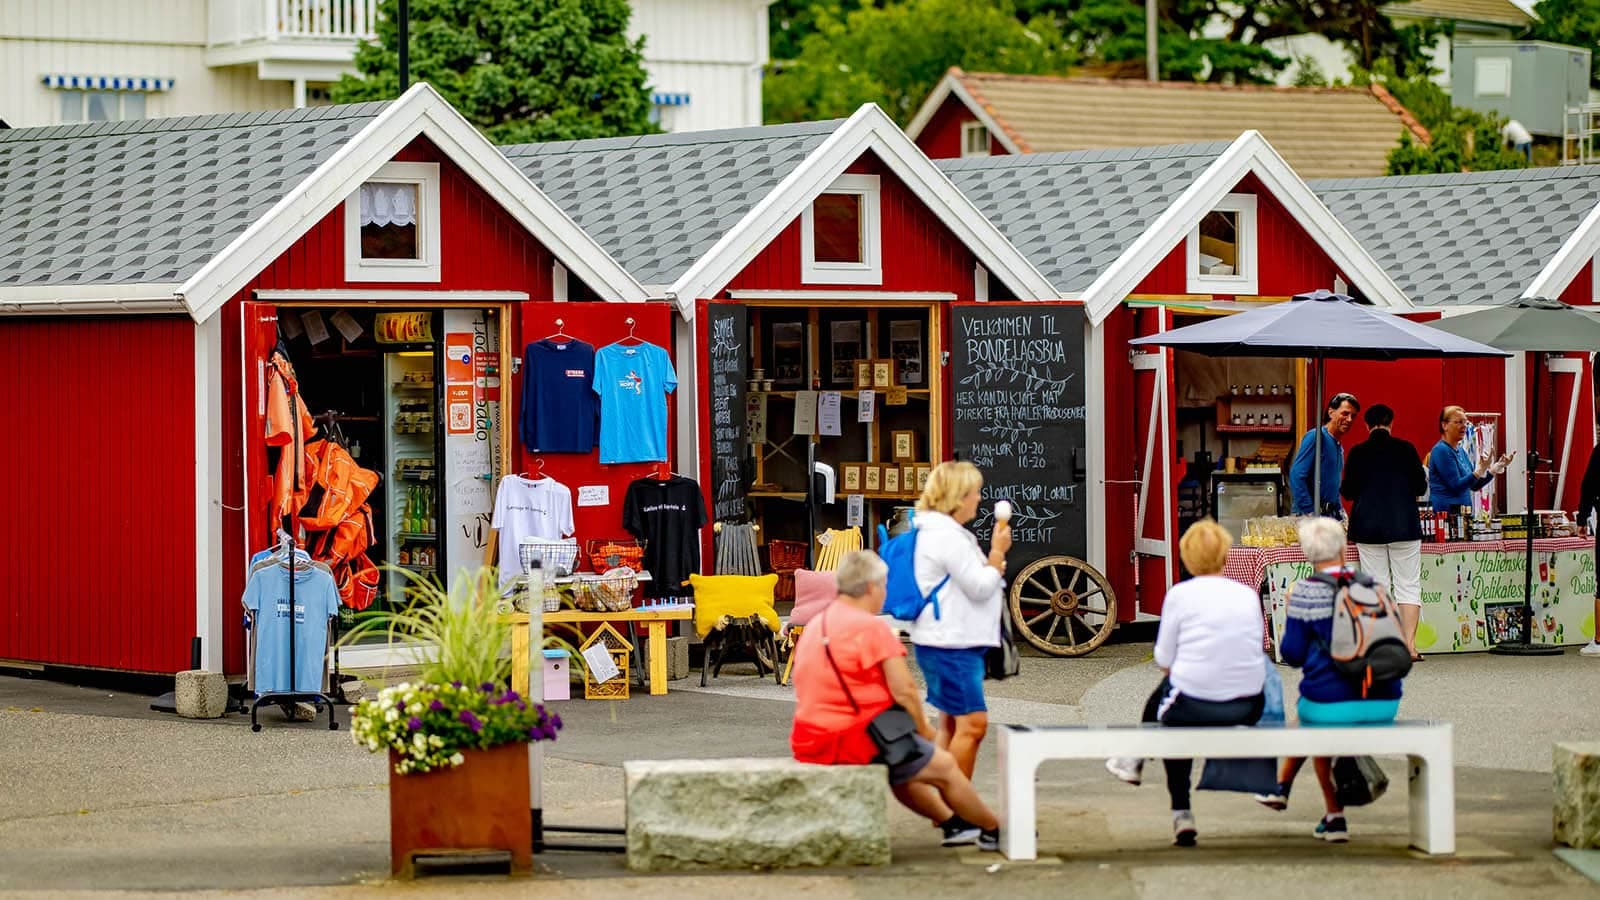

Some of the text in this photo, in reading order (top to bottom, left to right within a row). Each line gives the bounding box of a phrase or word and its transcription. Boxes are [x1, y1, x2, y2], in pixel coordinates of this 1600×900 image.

[961, 314, 1061, 337] VELKOMMEN TIL
[966, 338, 1067, 364] BONDELAGSBUA
[956, 391, 975, 405] HER
[1042, 390, 1060, 404] MAT
[955, 406, 993, 420] DIREKTE
[1018, 442, 1044, 455] 10-20
[974, 456, 1046, 468] SØN 10-20
